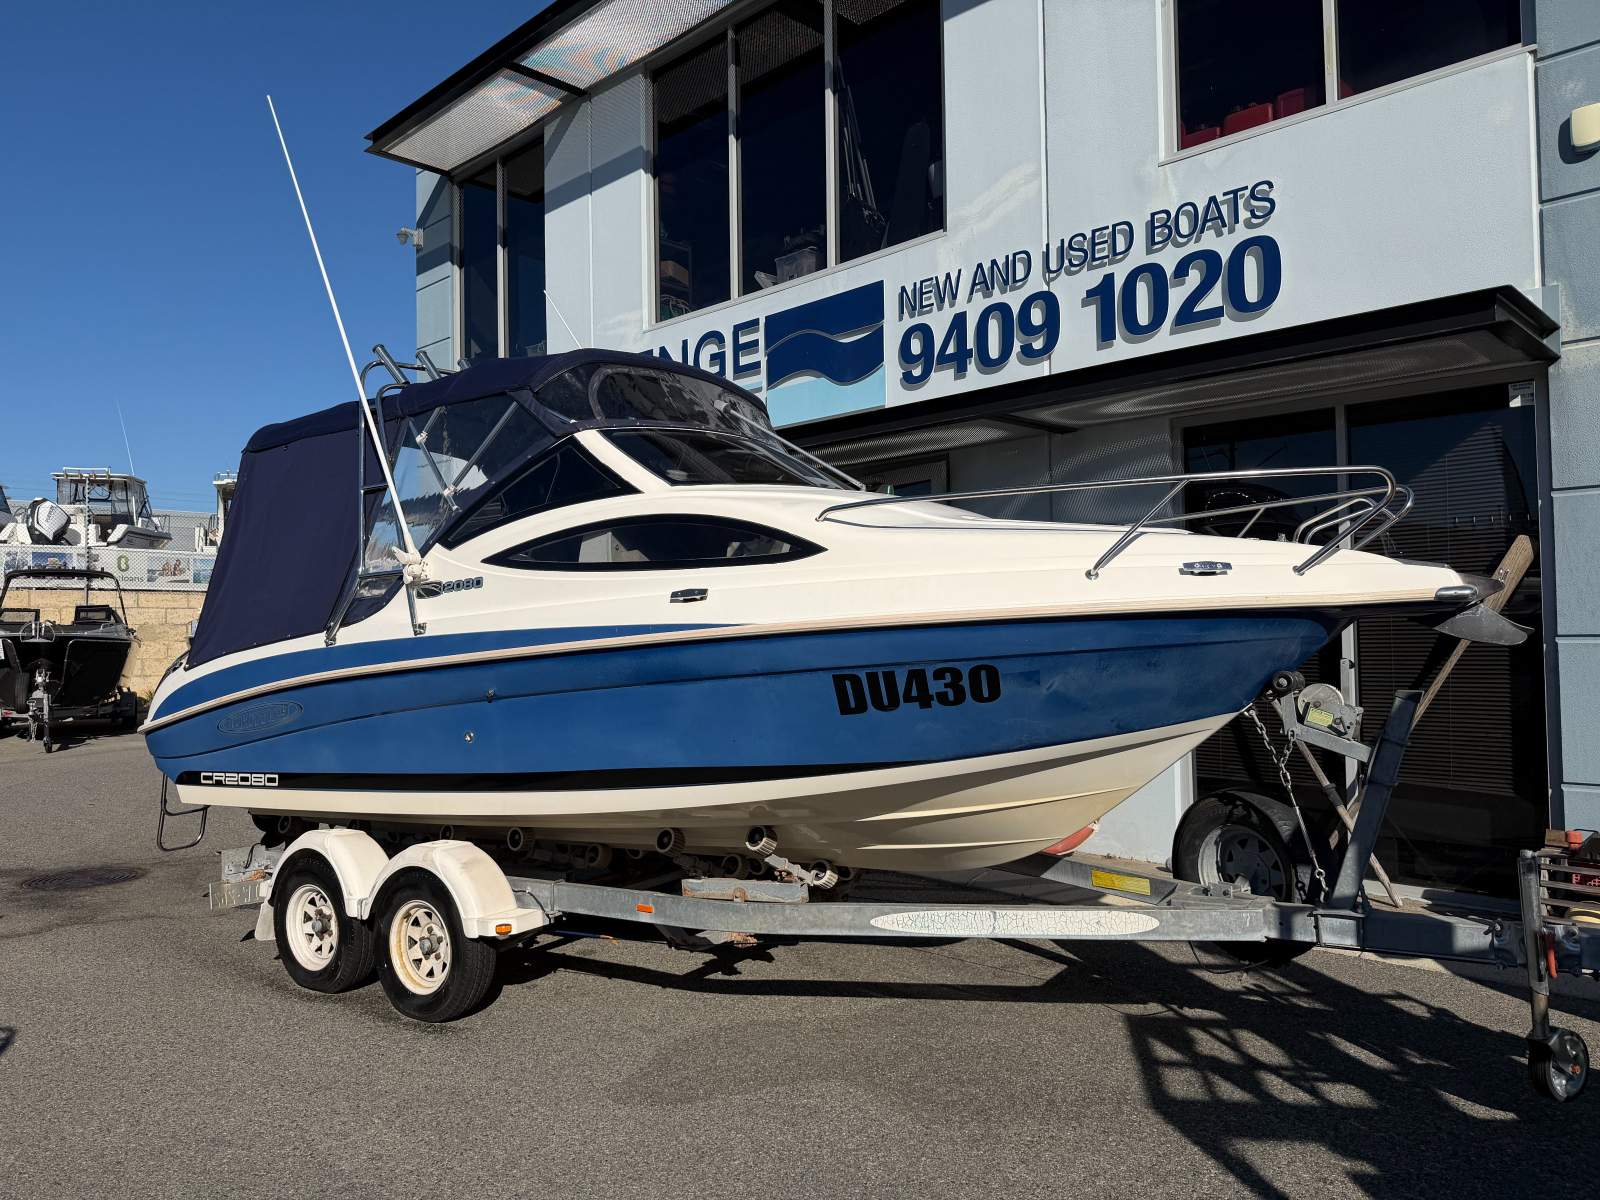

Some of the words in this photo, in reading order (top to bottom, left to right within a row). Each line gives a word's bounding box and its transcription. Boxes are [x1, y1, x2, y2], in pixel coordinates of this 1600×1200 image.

[899, 268, 962, 316] NEW
[967, 249, 1032, 303] AND
[1045, 220, 1135, 274] USED
[1149, 179, 1277, 247] BOATS
[899, 290, 1061, 385] 9409
[1085, 235, 1282, 343] 1020
[443, 576, 484, 594] 2080
[831, 664, 1001, 716] DU430
[200, 772, 279, 787] CR2080
